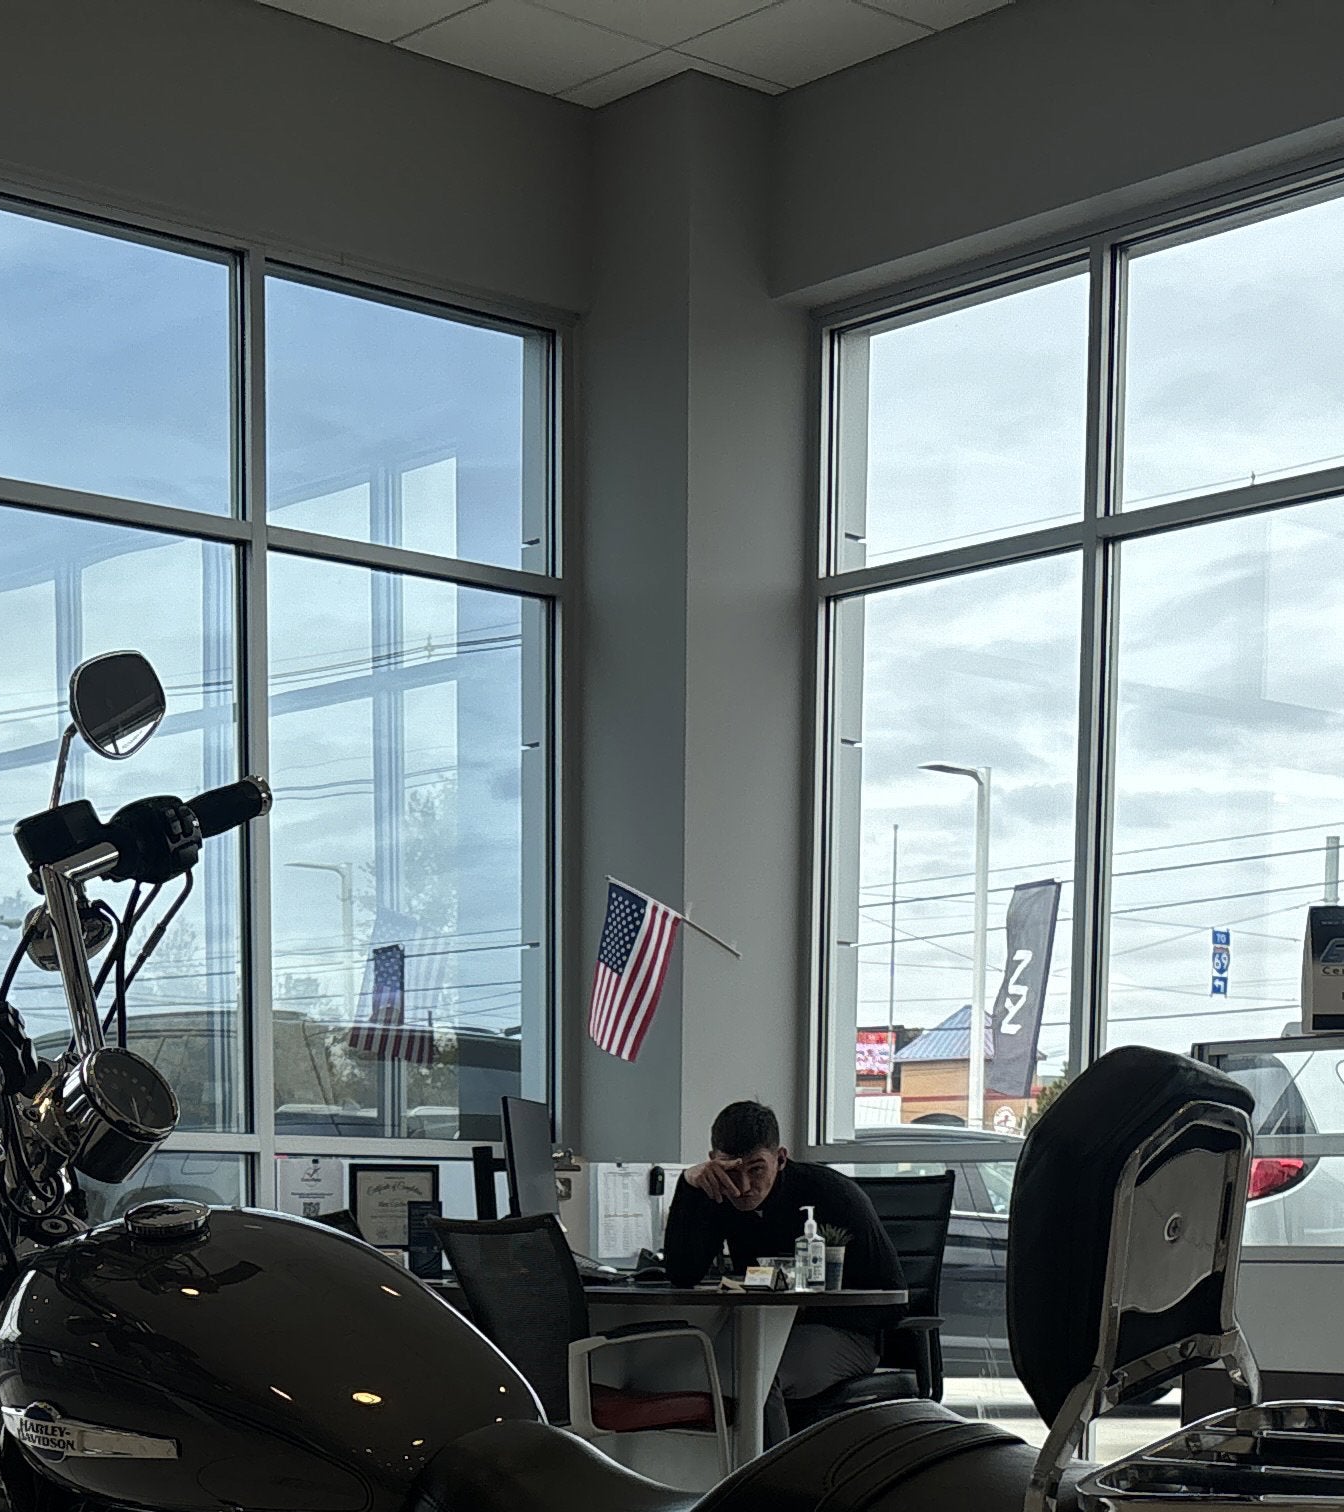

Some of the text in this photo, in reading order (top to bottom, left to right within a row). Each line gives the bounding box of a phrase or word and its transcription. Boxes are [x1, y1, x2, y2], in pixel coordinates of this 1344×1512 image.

[1215, 933, 1227, 944] TO
[1214, 953, 1228, 970] 69
[17, 1428, 76, 1451] DAVIDSON
